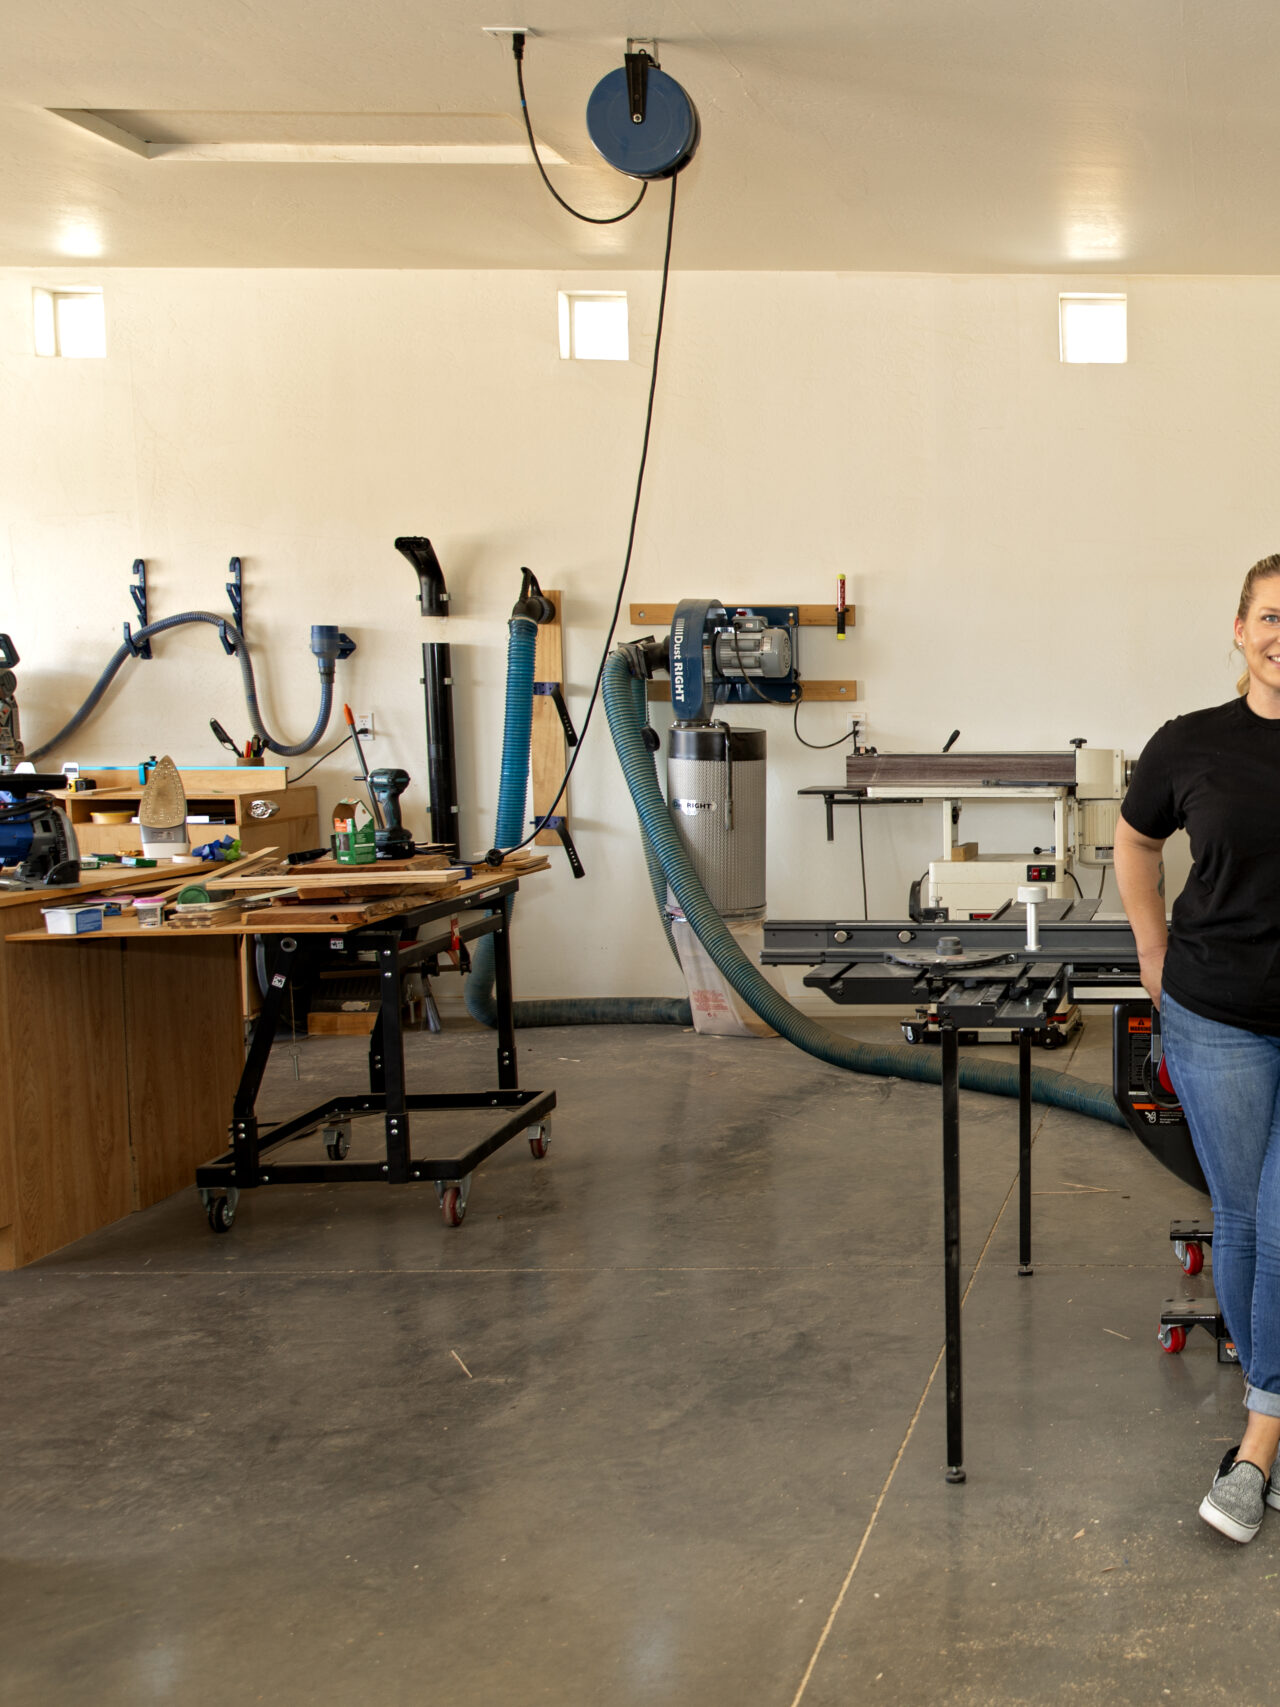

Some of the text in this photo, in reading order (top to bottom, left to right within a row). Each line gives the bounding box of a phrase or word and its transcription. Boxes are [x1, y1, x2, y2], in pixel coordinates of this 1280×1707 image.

[673, 635, 685, 703] Dust RIGHT
[686, 802, 713, 810] RIGHT
